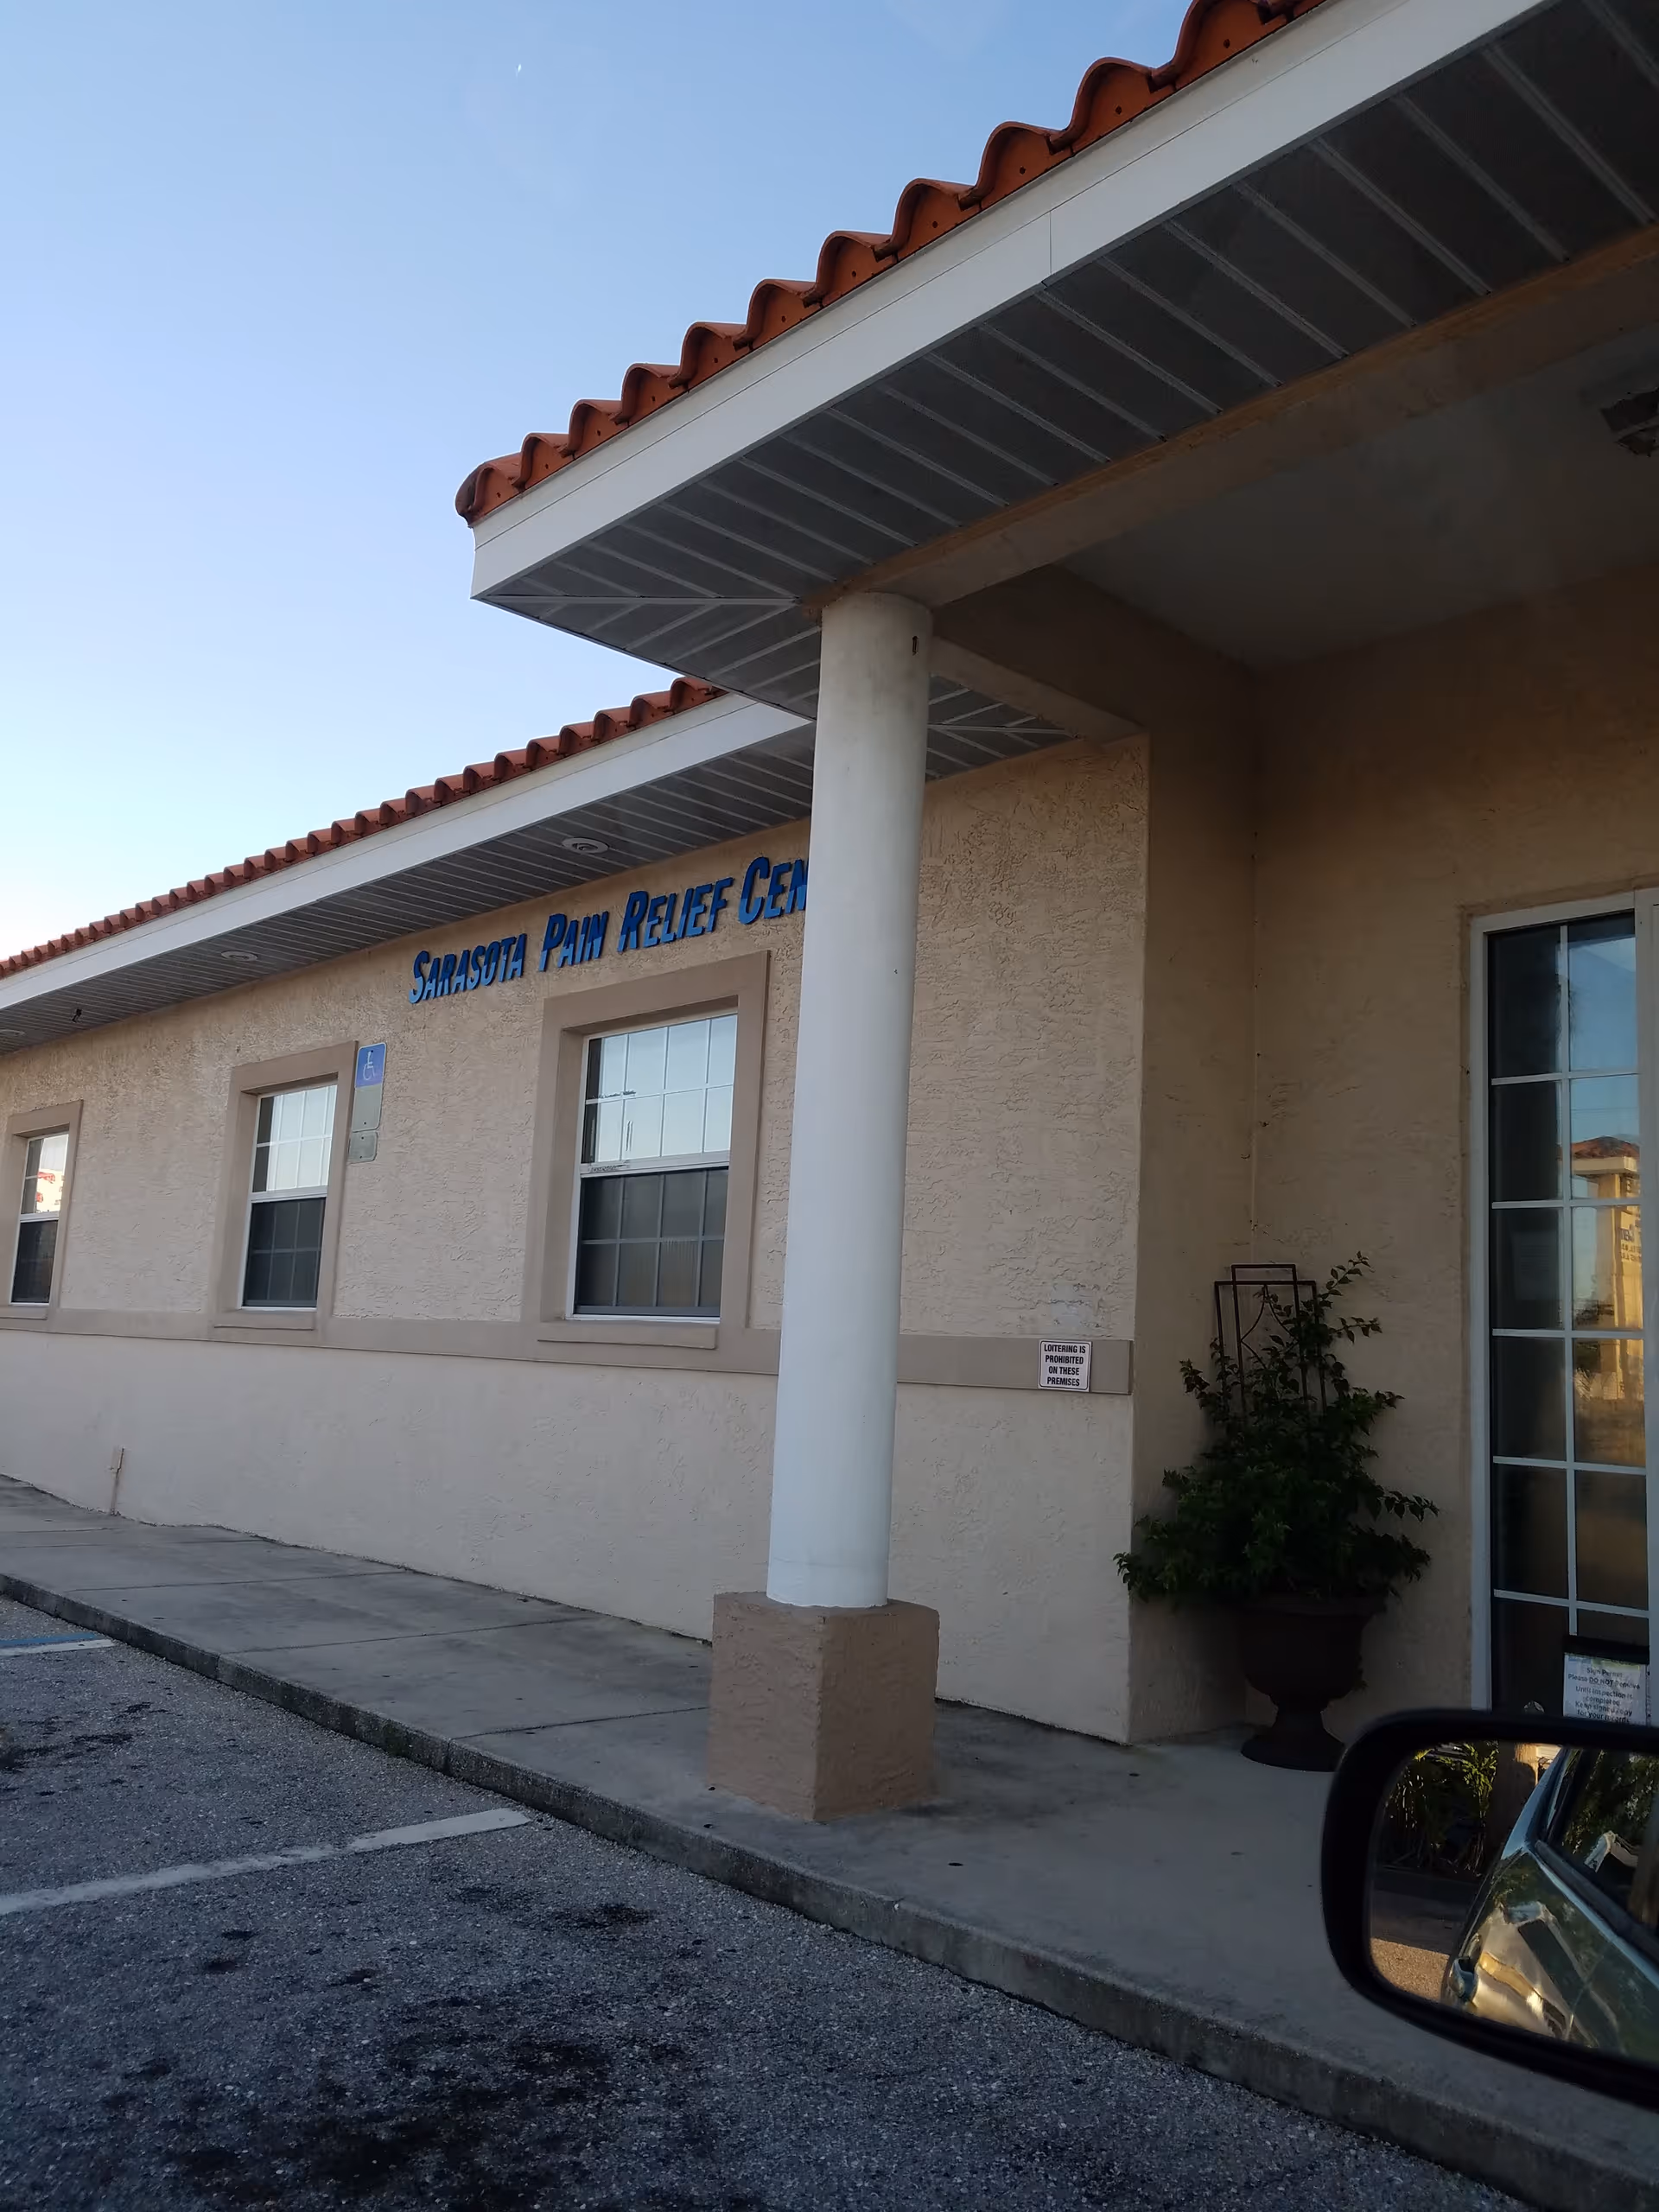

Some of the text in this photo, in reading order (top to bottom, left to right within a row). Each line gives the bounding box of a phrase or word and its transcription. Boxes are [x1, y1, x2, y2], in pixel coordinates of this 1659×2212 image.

[409, 932, 528, 1005] SARASOTA
[538, 911, 610, 973] PAIN
[617, 877, 735, 953] RELIEF
[1044, 1344, 1086, 1354] LOITERING IS
[1045, 1355, 1084, 1364] PROHIBITED
[1048, 1365, 1080, 1376] ON THESE
[1046, 1376, 1080, 1387] PREMISES
